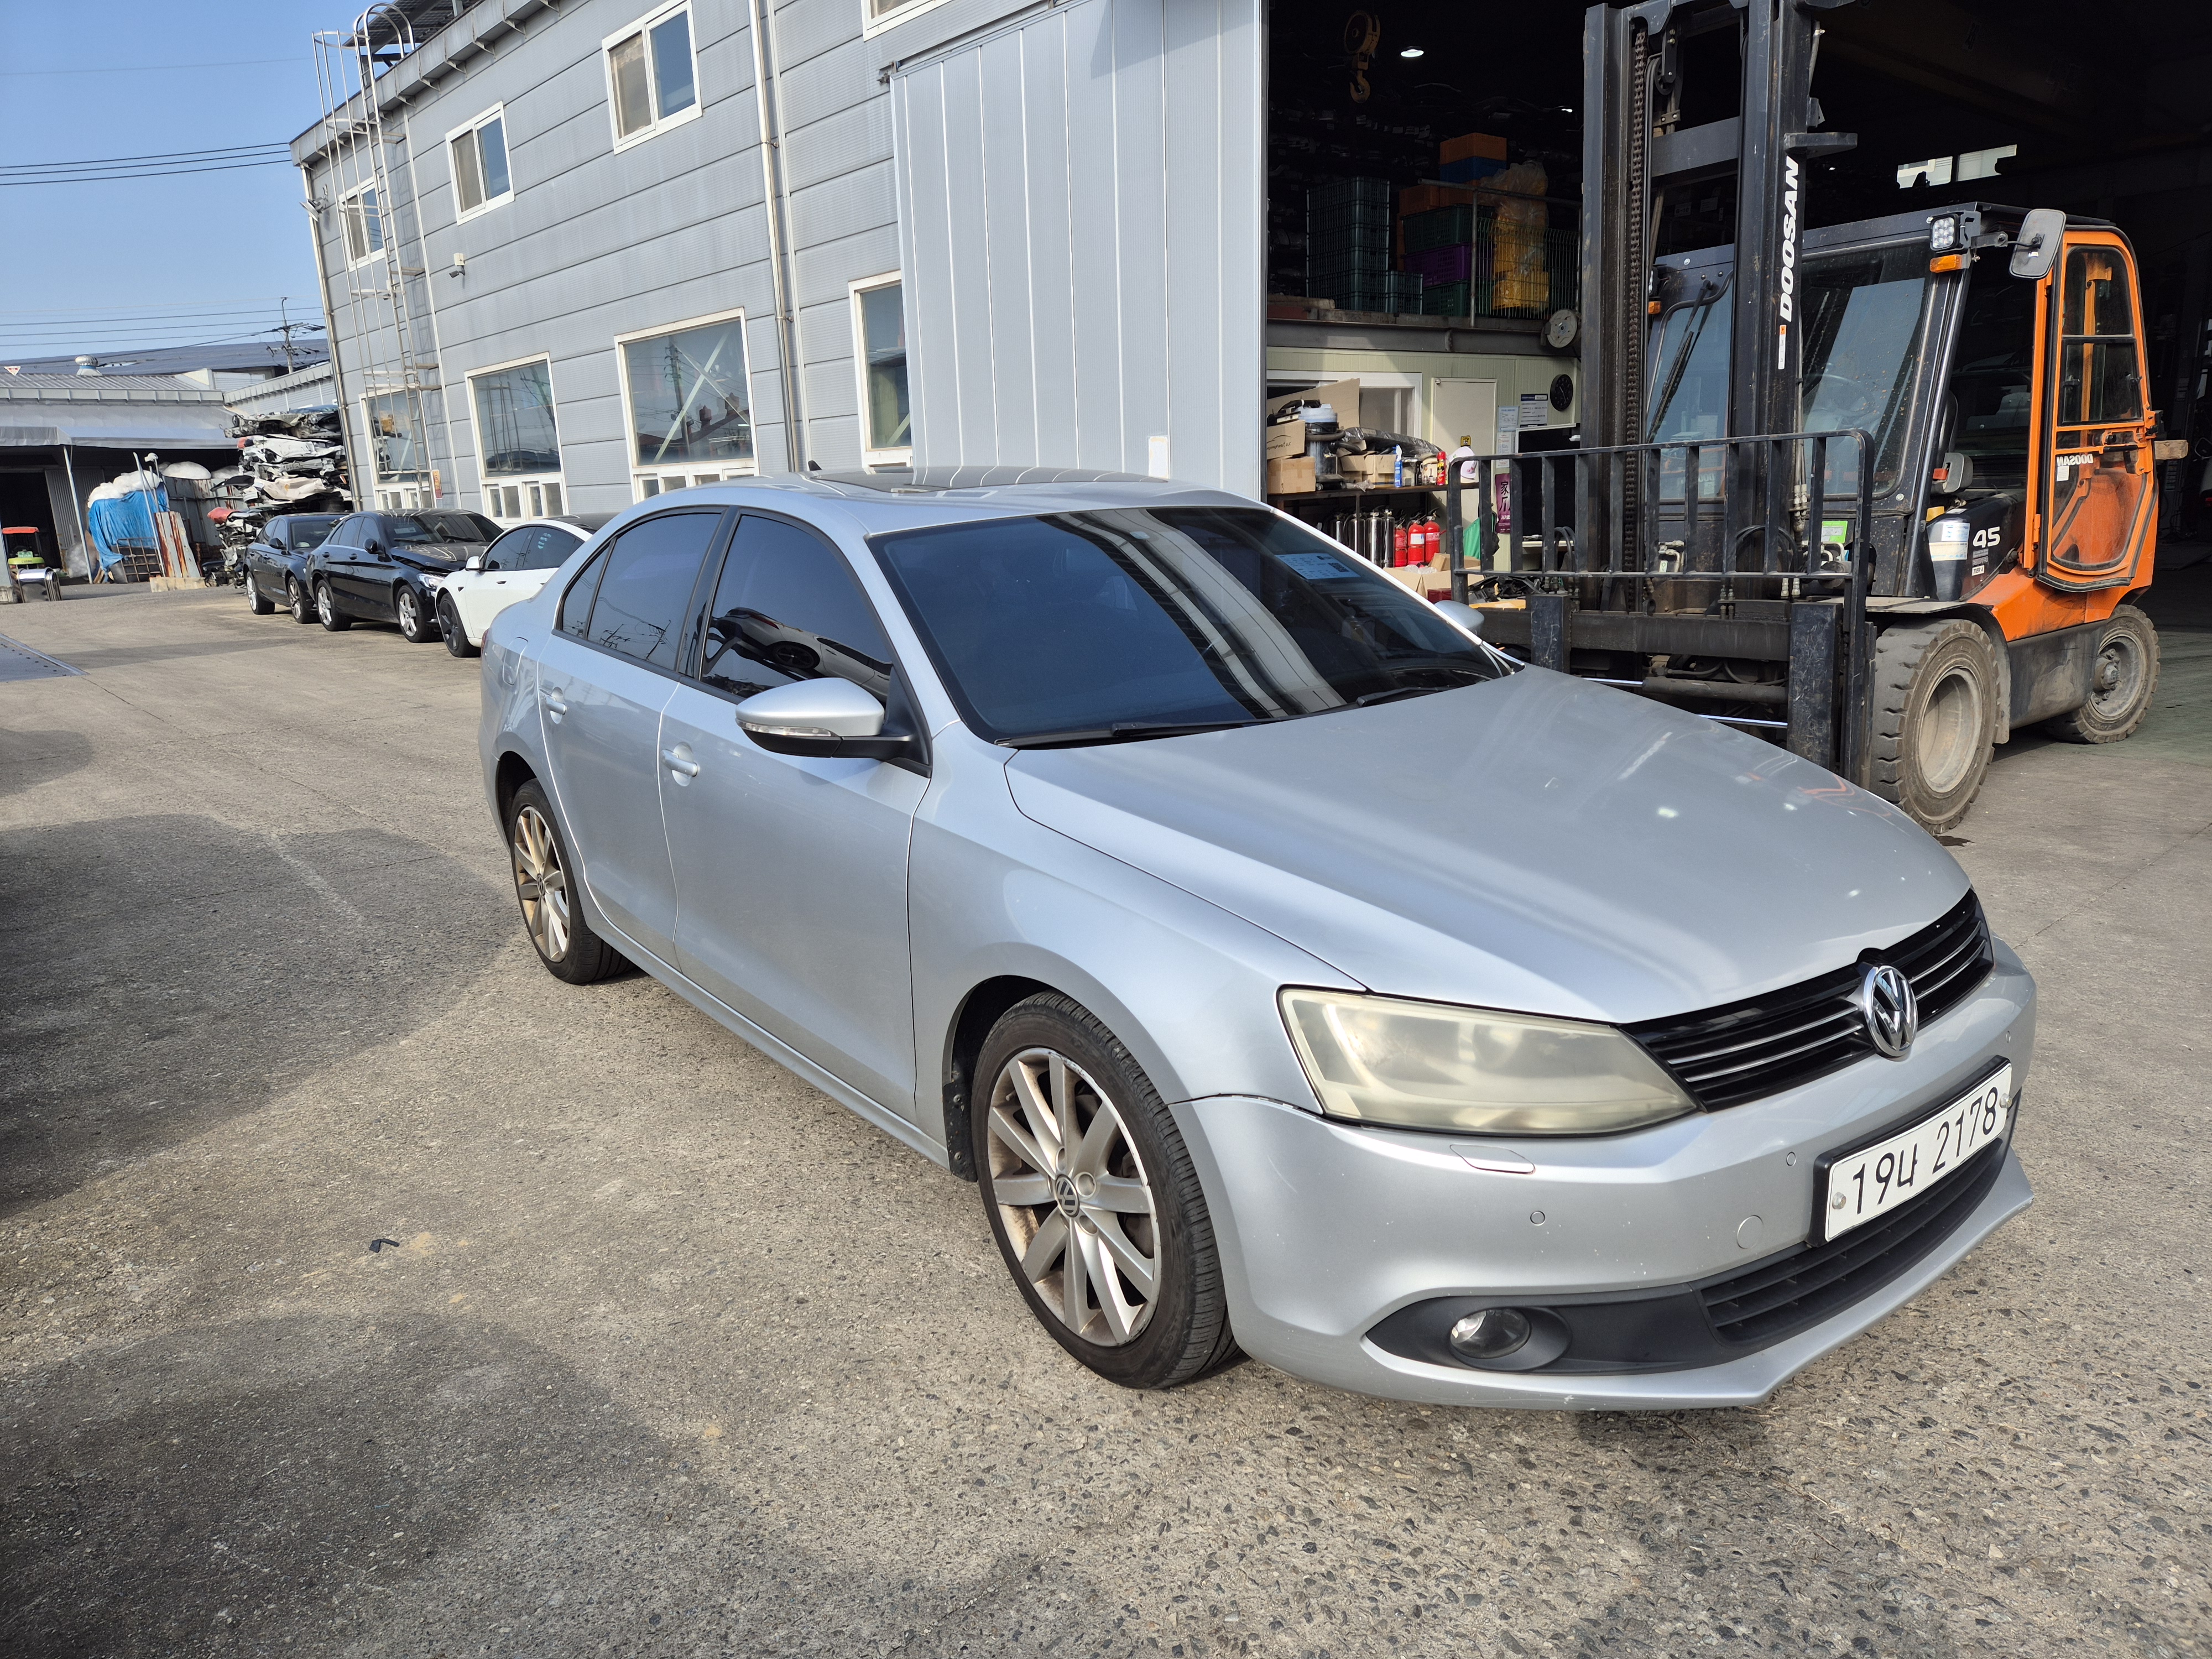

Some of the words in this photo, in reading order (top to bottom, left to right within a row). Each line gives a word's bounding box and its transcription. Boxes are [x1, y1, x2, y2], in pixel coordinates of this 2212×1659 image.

[1780, 155, 1798, 322] DOOSAN
[1973, 526, 2001, 548] 45
[1853, 1142, 1918, 1215] 19나
[1932, 1086, 1999, 1175] 2178
